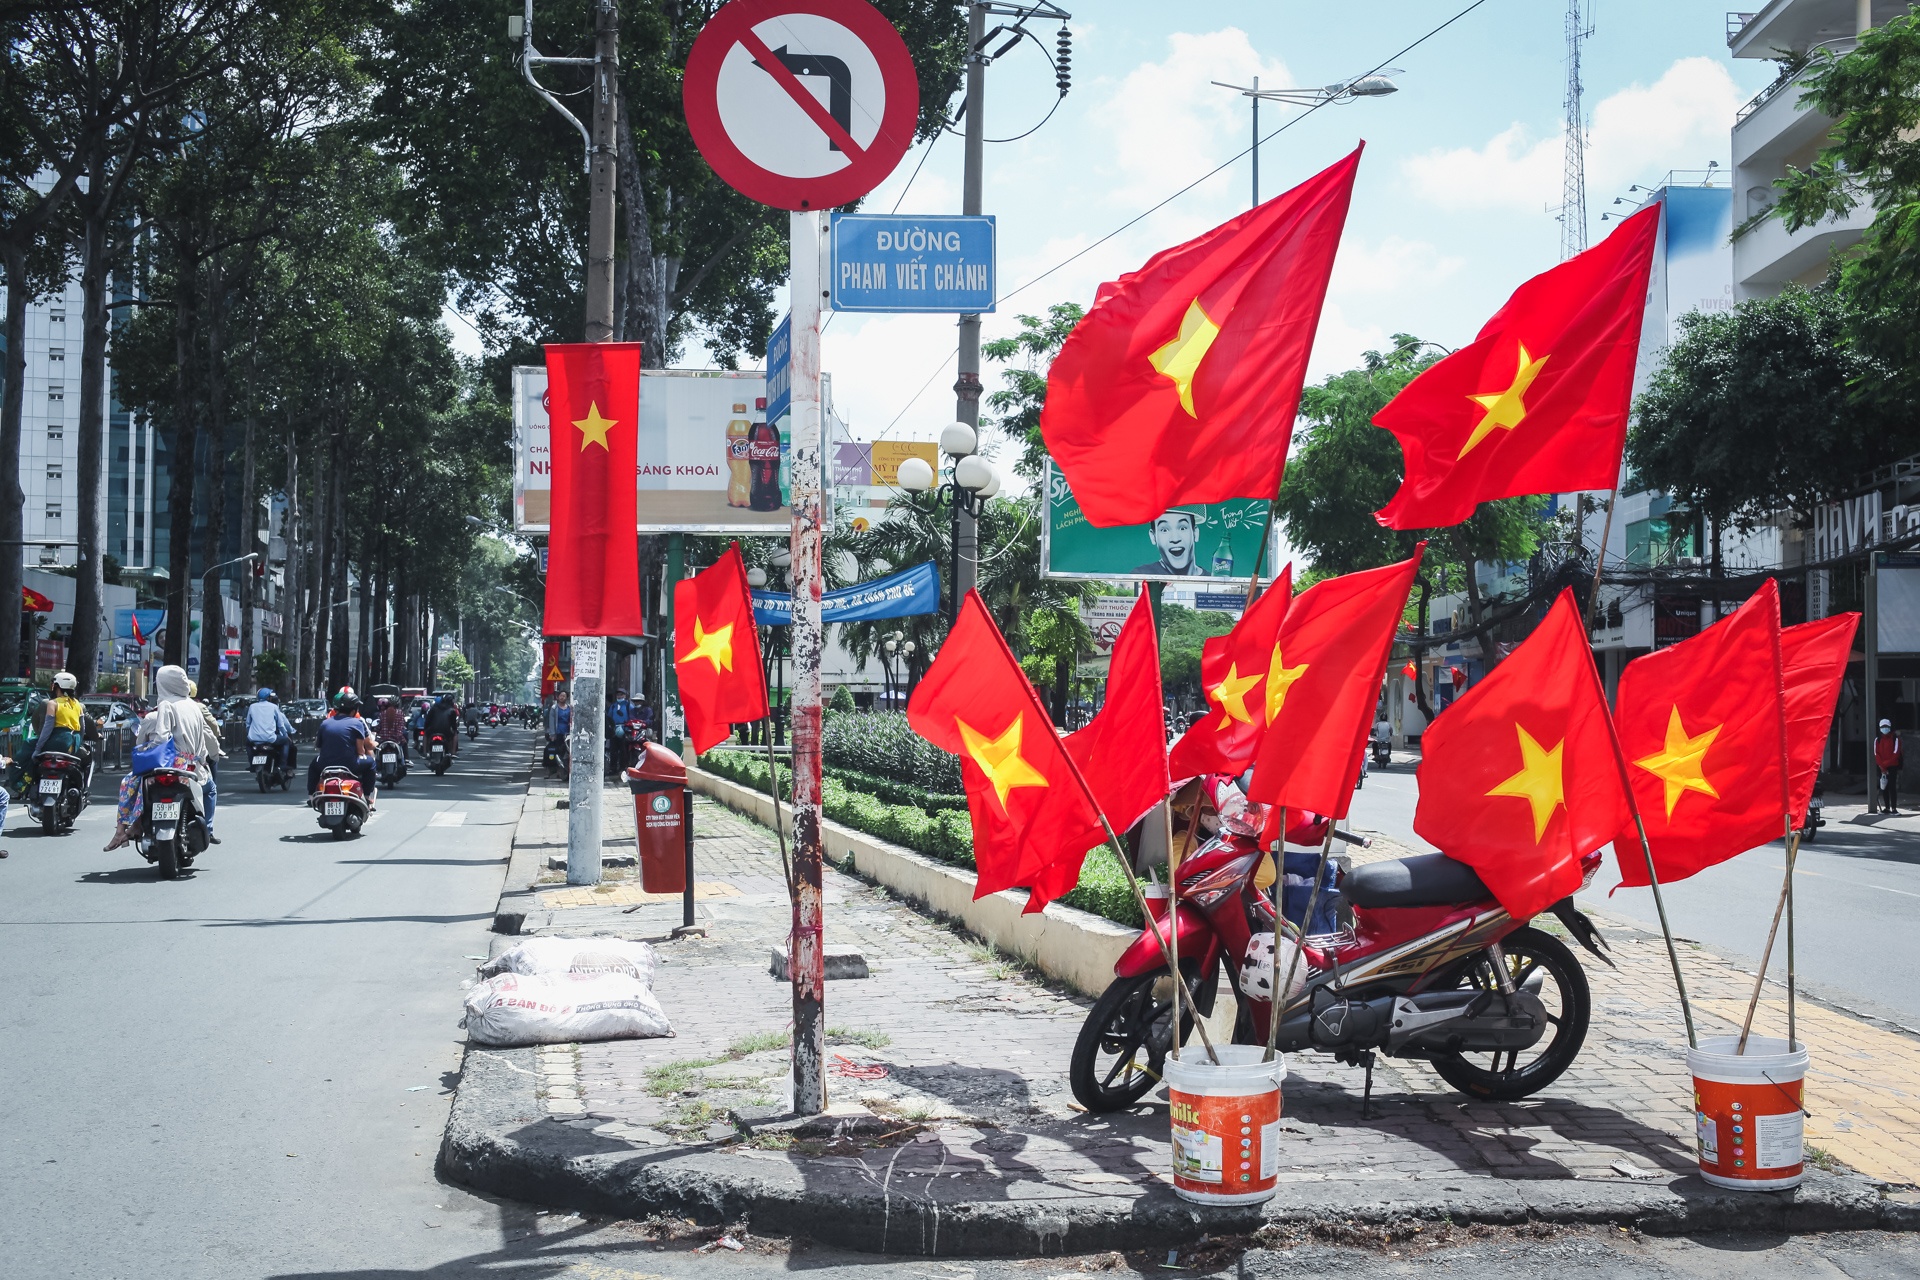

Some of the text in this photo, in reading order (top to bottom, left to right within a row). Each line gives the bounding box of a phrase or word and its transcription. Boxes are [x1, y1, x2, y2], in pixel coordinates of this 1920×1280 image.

[877, 226, 961, 252] ĐƯỜNG
[841, 255, 988, 294] PHẠM VIẾT CHÁNH
[751, 446, 780, 457] Coca-Cola
[676, 463, 719, 476] KHOÁI
[1220, 507, 1243, 521] Trong
[1675, 609, 1697, 617] Unique
